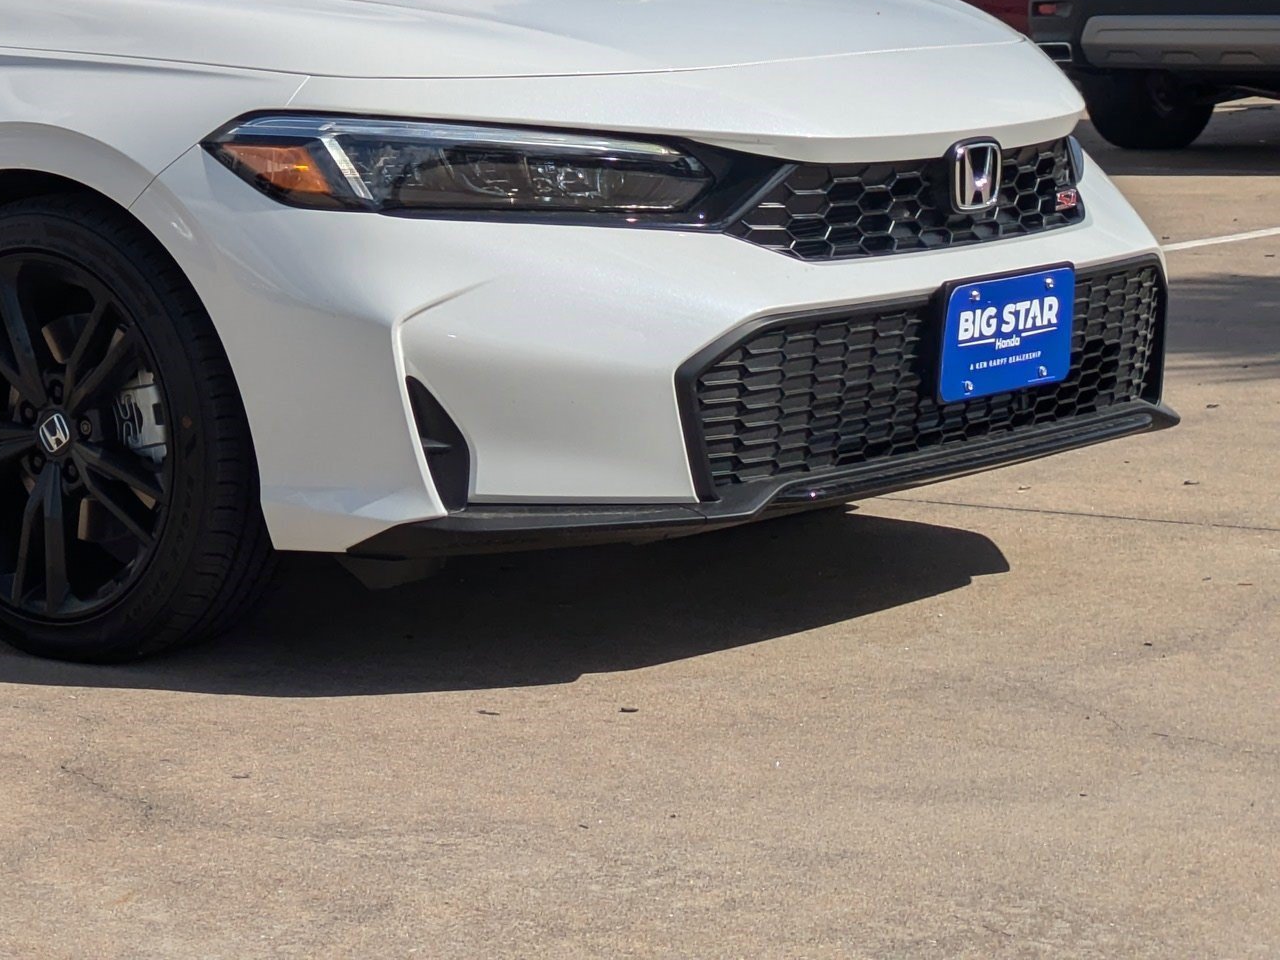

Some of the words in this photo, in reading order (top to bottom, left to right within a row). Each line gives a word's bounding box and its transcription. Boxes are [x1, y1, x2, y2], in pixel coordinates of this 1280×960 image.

[958, 307, 997, 341] BIG
[1001, 296, 1059, 333] STAR
[995, 334, 1020, 350] Honda
